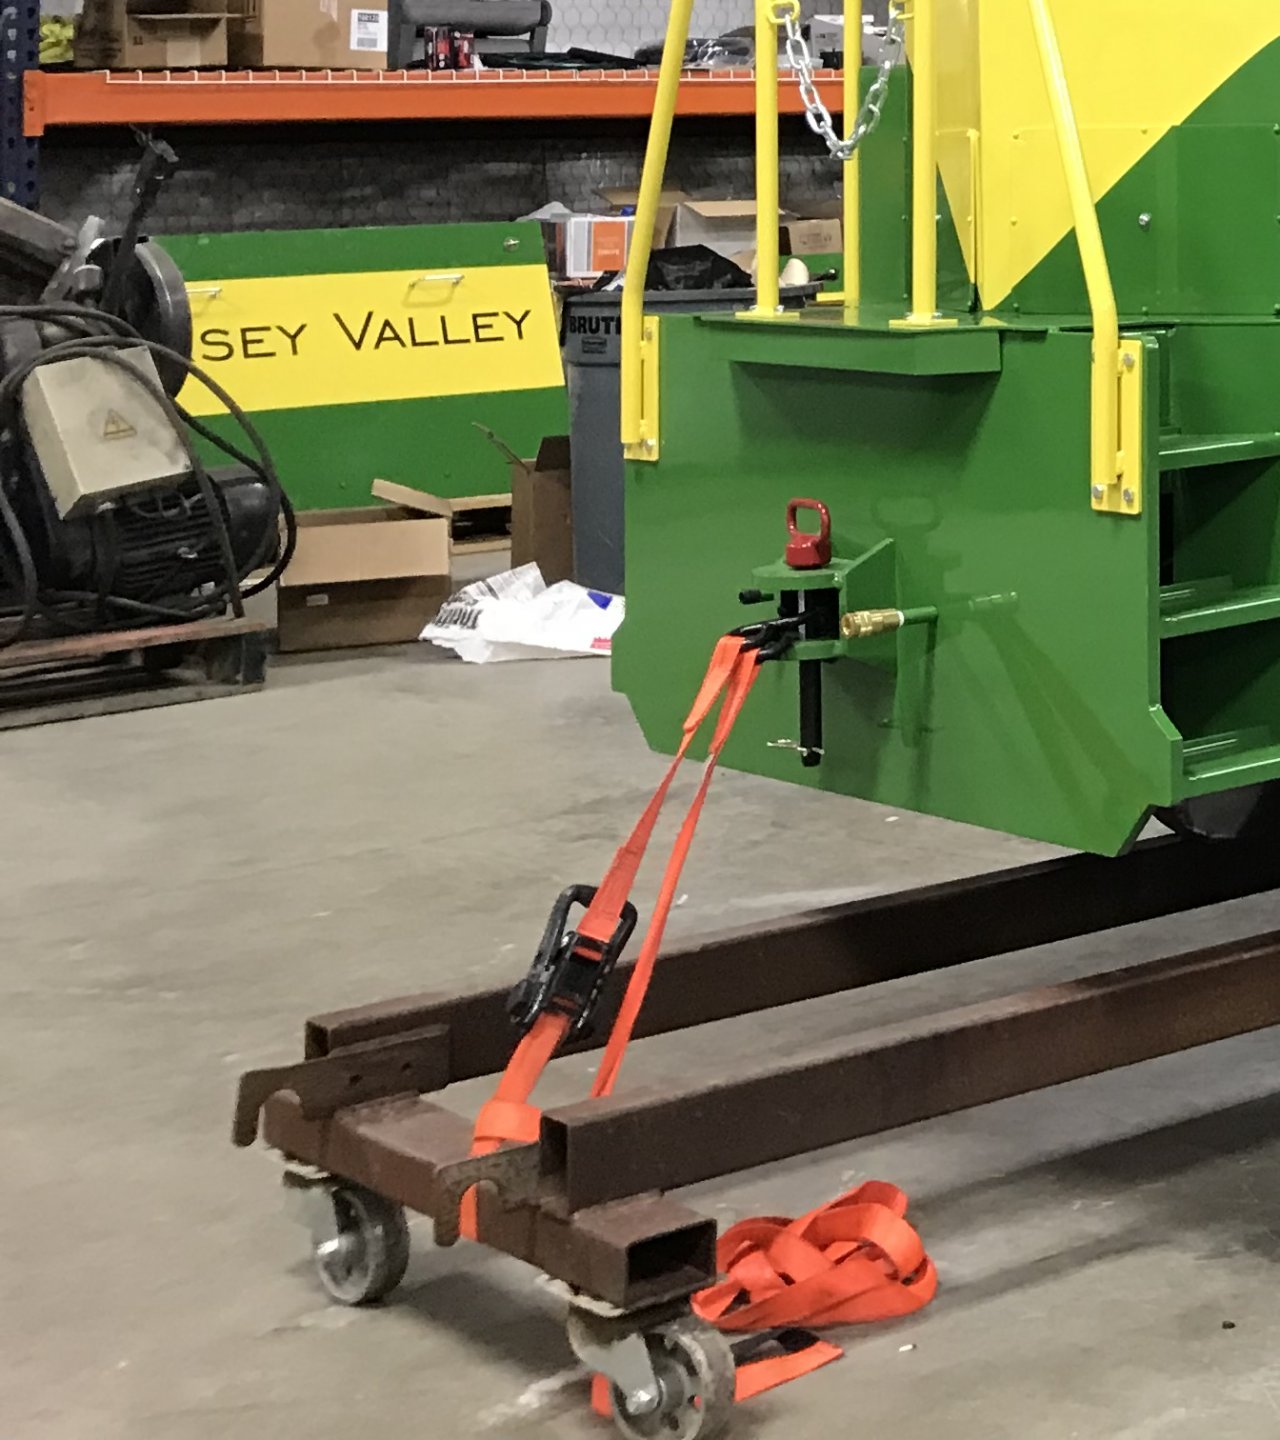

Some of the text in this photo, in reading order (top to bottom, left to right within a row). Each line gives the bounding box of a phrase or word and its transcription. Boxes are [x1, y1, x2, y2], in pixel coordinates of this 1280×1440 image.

[192, 309, 532, 361] SEY VALLEY
[569, 315, 622, 336] BRUT
